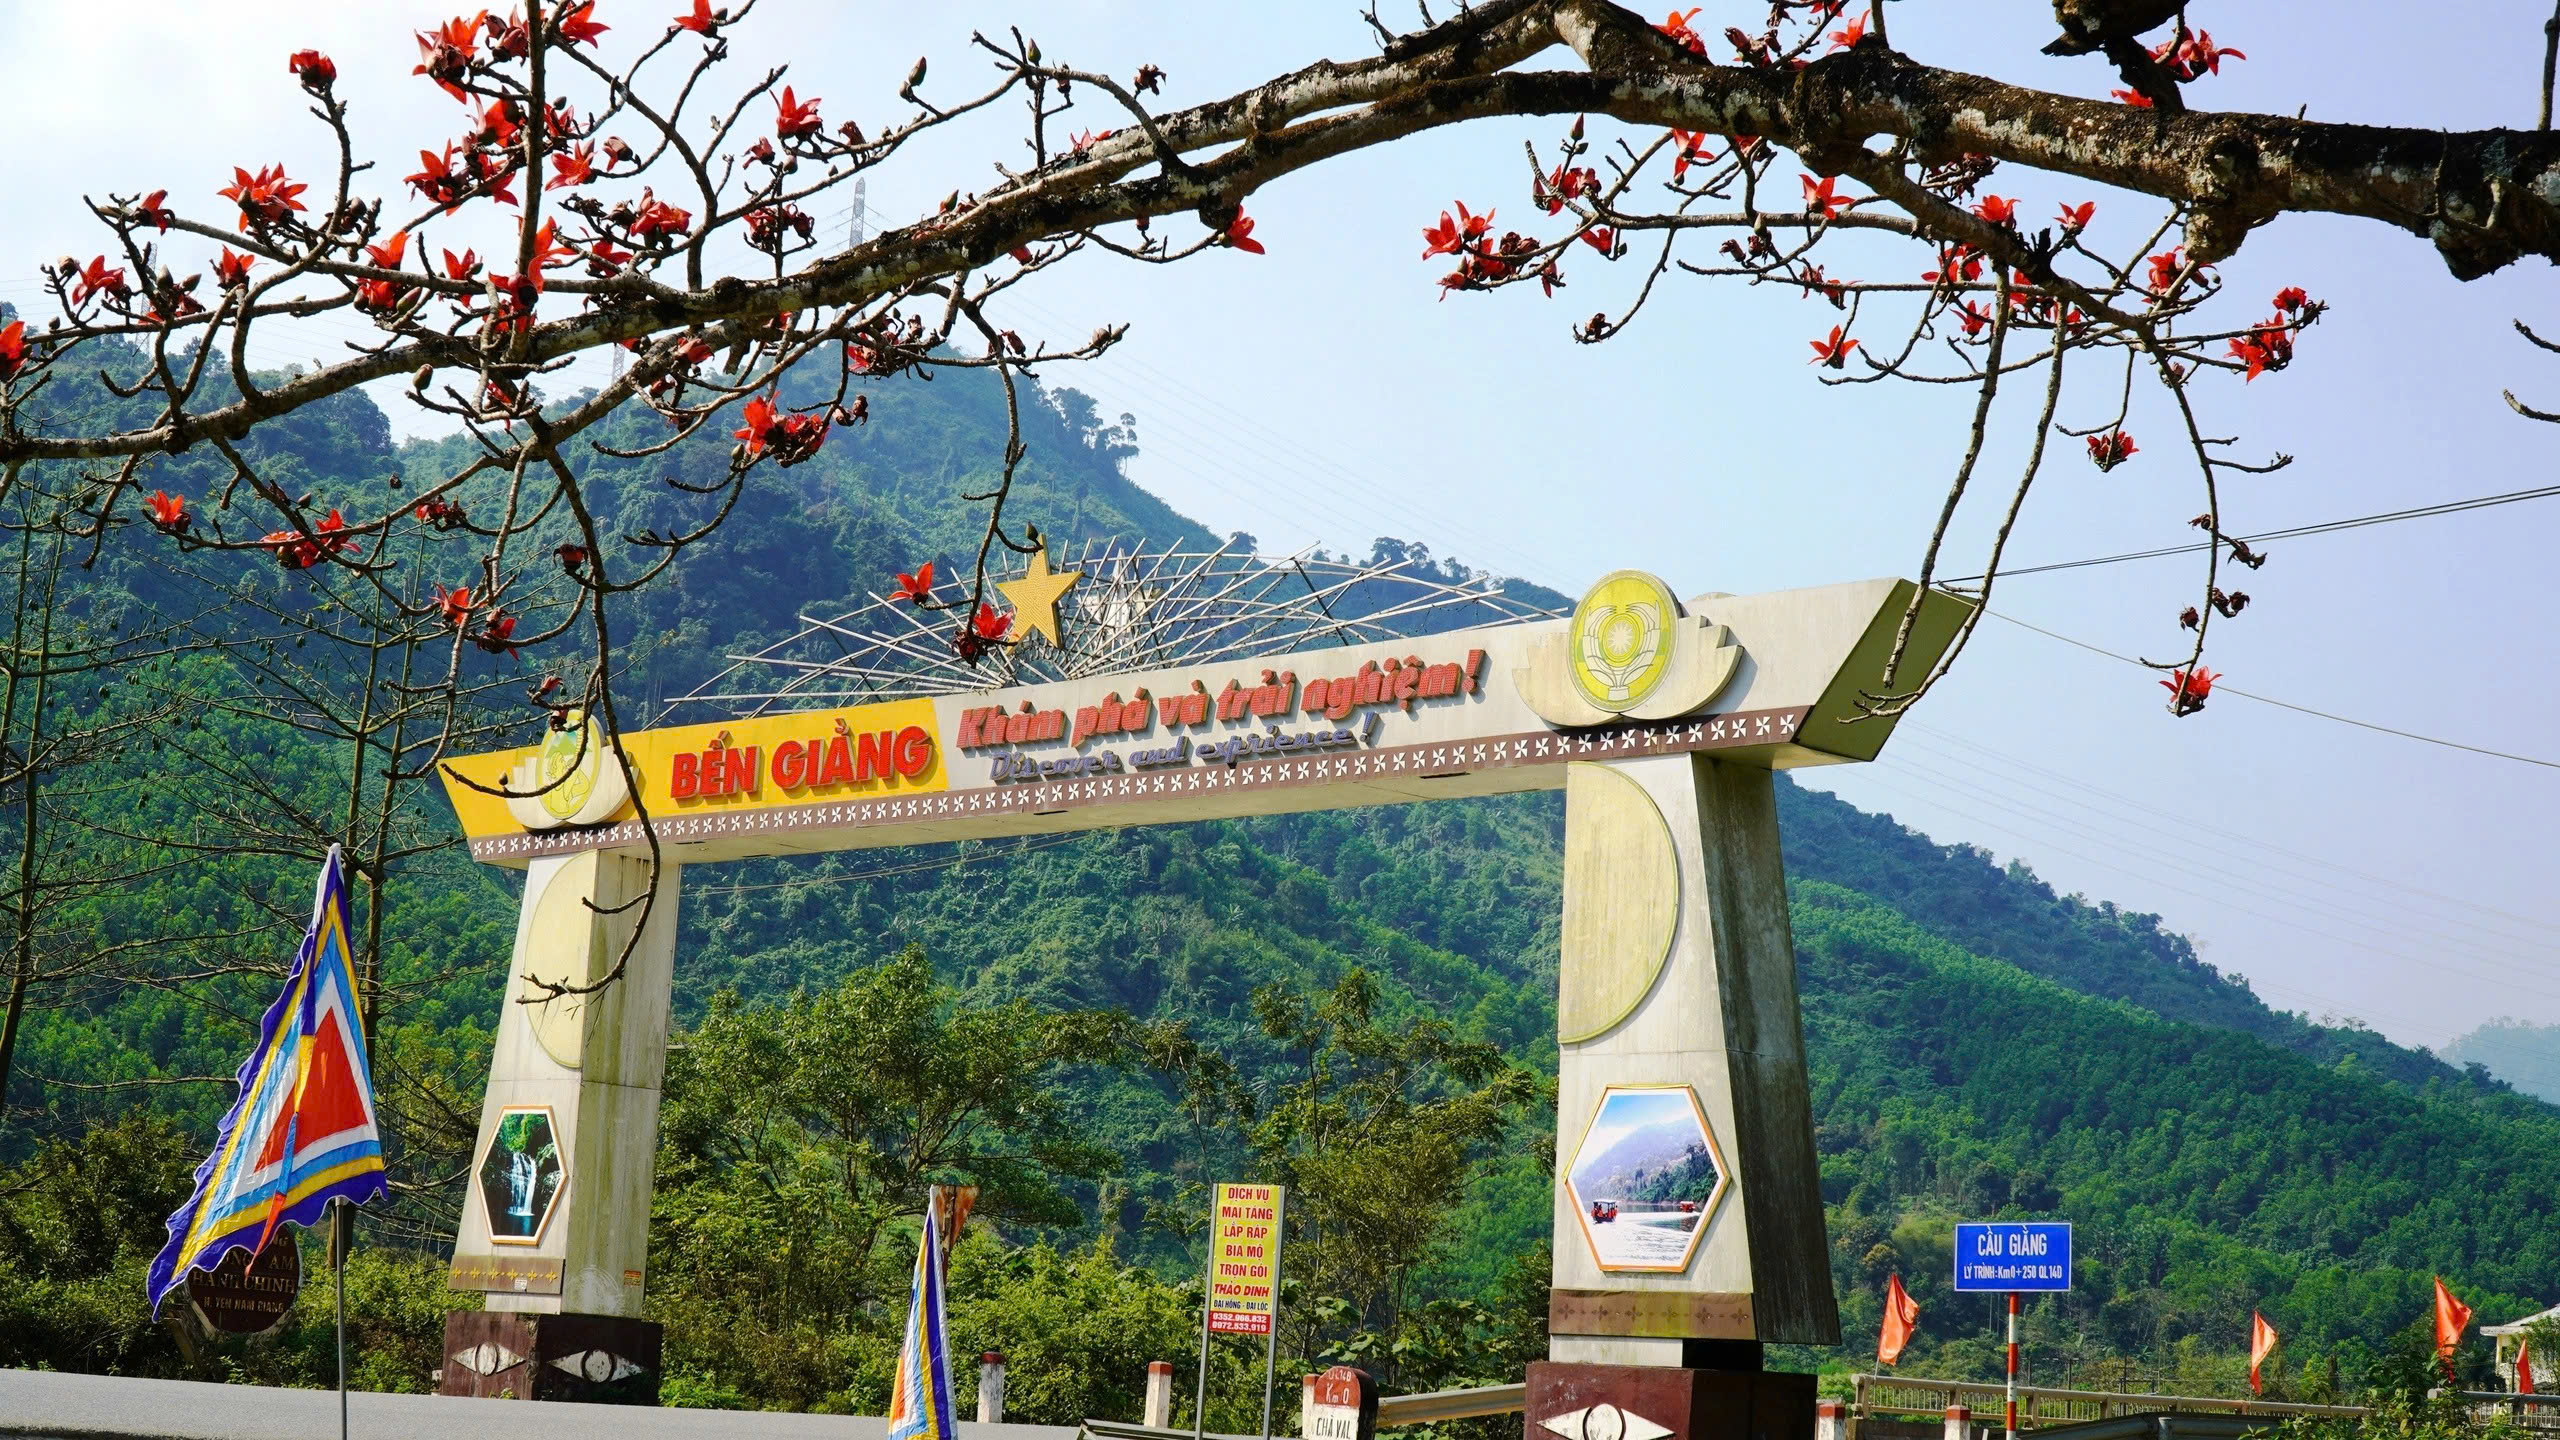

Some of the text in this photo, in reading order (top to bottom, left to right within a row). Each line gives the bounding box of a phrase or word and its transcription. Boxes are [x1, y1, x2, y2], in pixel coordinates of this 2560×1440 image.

[956, 700, 1066, 749] Khám
[1071, 687, 1151, 748] phá
[1159, 680, 1210, 726] và
[1216, 669, 1297, 721] trải
[671, 730, 760, 799] BẾN
[990, 750, 1121, 780] Discover
[1129, 736, 1188, 767] and
[1228, 1187, 1269, 1203] DỊCH VỤ
[1222, 1205, 1273, 1220] MAI TÁNG
[1247, 1224, 1268, 1238] RÁP
[1978, 1225, 2002, 1256] CẦU
[1226, 1244, 1263, 1260] BIA MỘ
[1220, 1263, 1267, 1278] TRỌN GÓI
[1963, 1263, 1973, 1279] LÝ
[1214, 1281, 1269, 1298] THẢO DINH
[1316, 1415, 1350, 1439] CHÀ VAL
